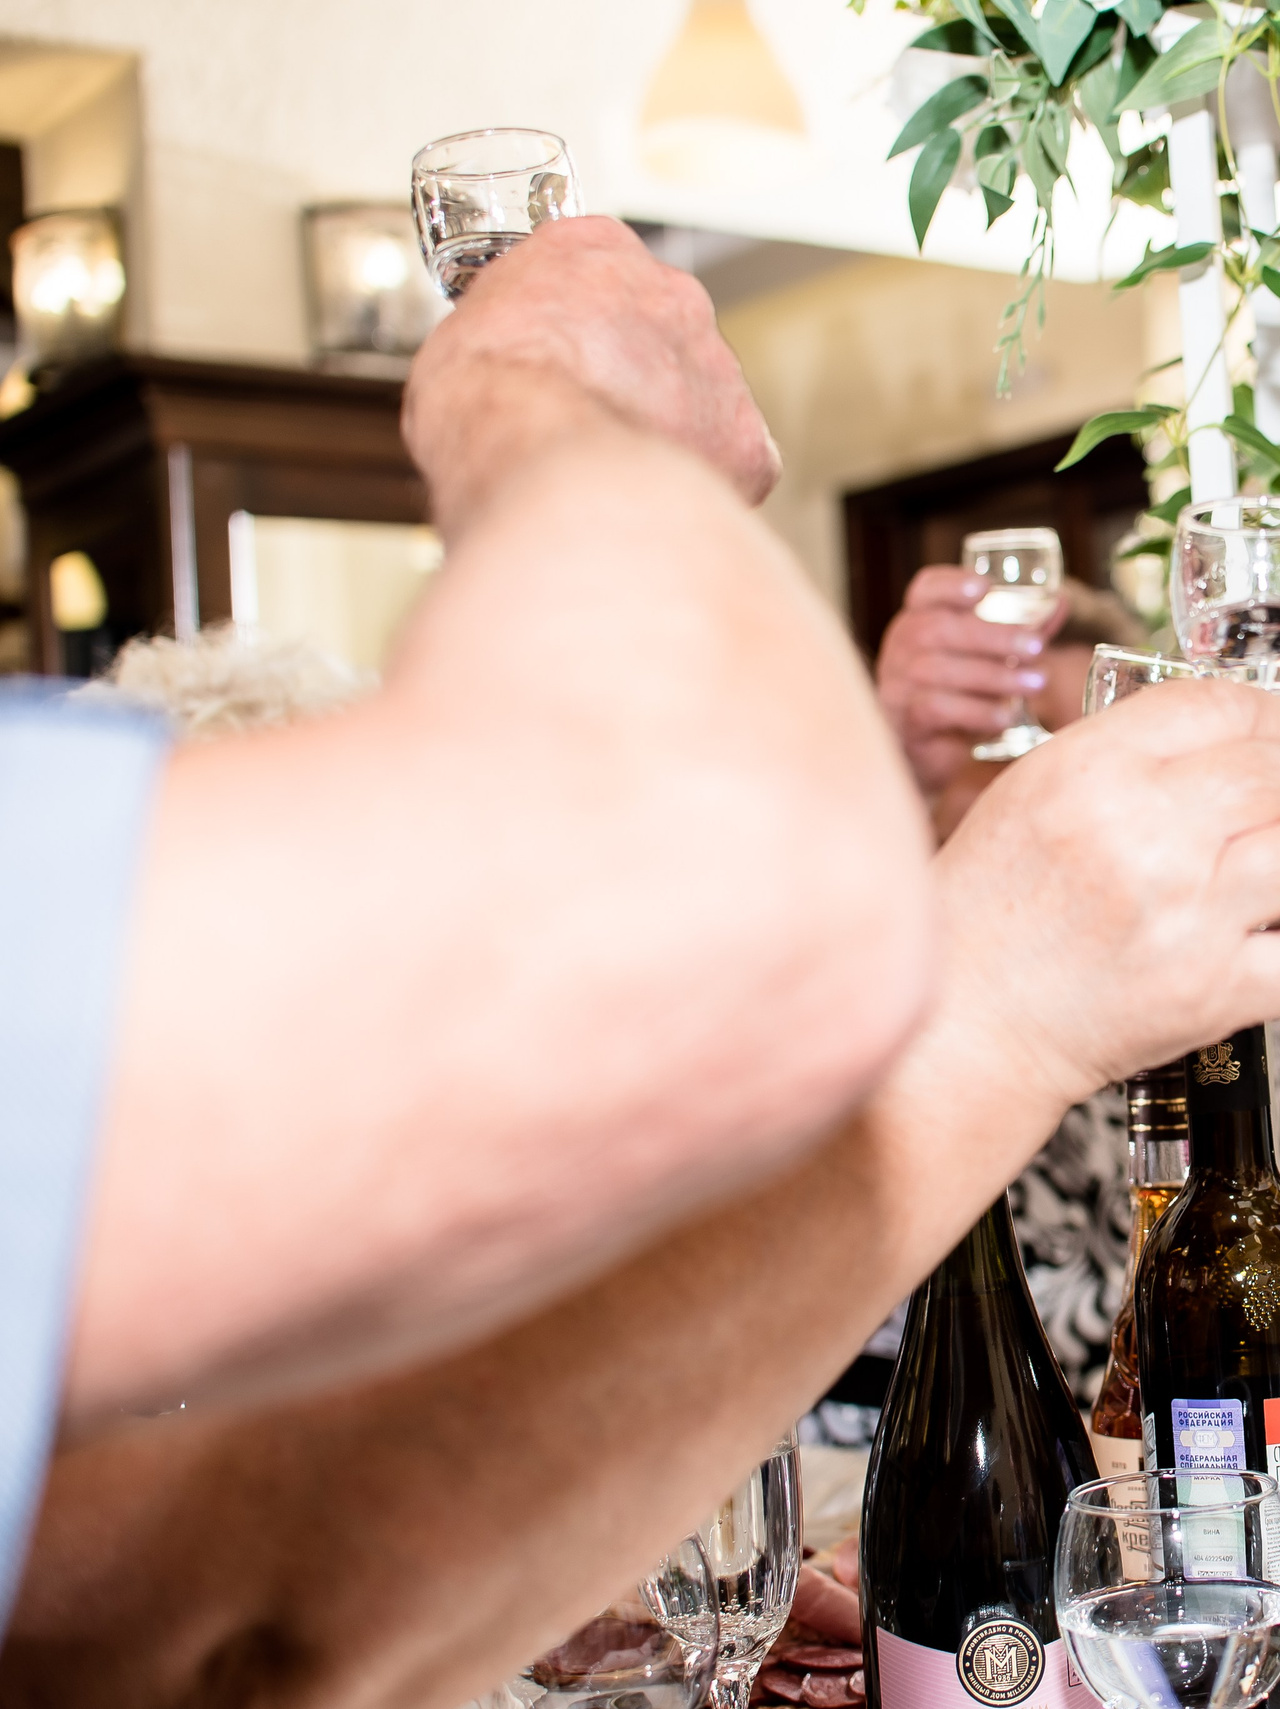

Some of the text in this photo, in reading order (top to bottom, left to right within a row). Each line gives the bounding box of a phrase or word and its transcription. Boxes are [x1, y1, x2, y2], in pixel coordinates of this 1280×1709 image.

[1178, 1410, 1233, 1419] РОССИЙСКАЯ
[1179, 1419, 1233, 1427] ФЕДЕРАЦИЯ
[967, 1626, 1007, 1656] ПРОИЗВЕДЕНО
[1014, 1629, 1035, 1651] РОССИИ
[967, 1666, 1036, 1700] ВИННЫЙ ДОМ MILLSTREAM
